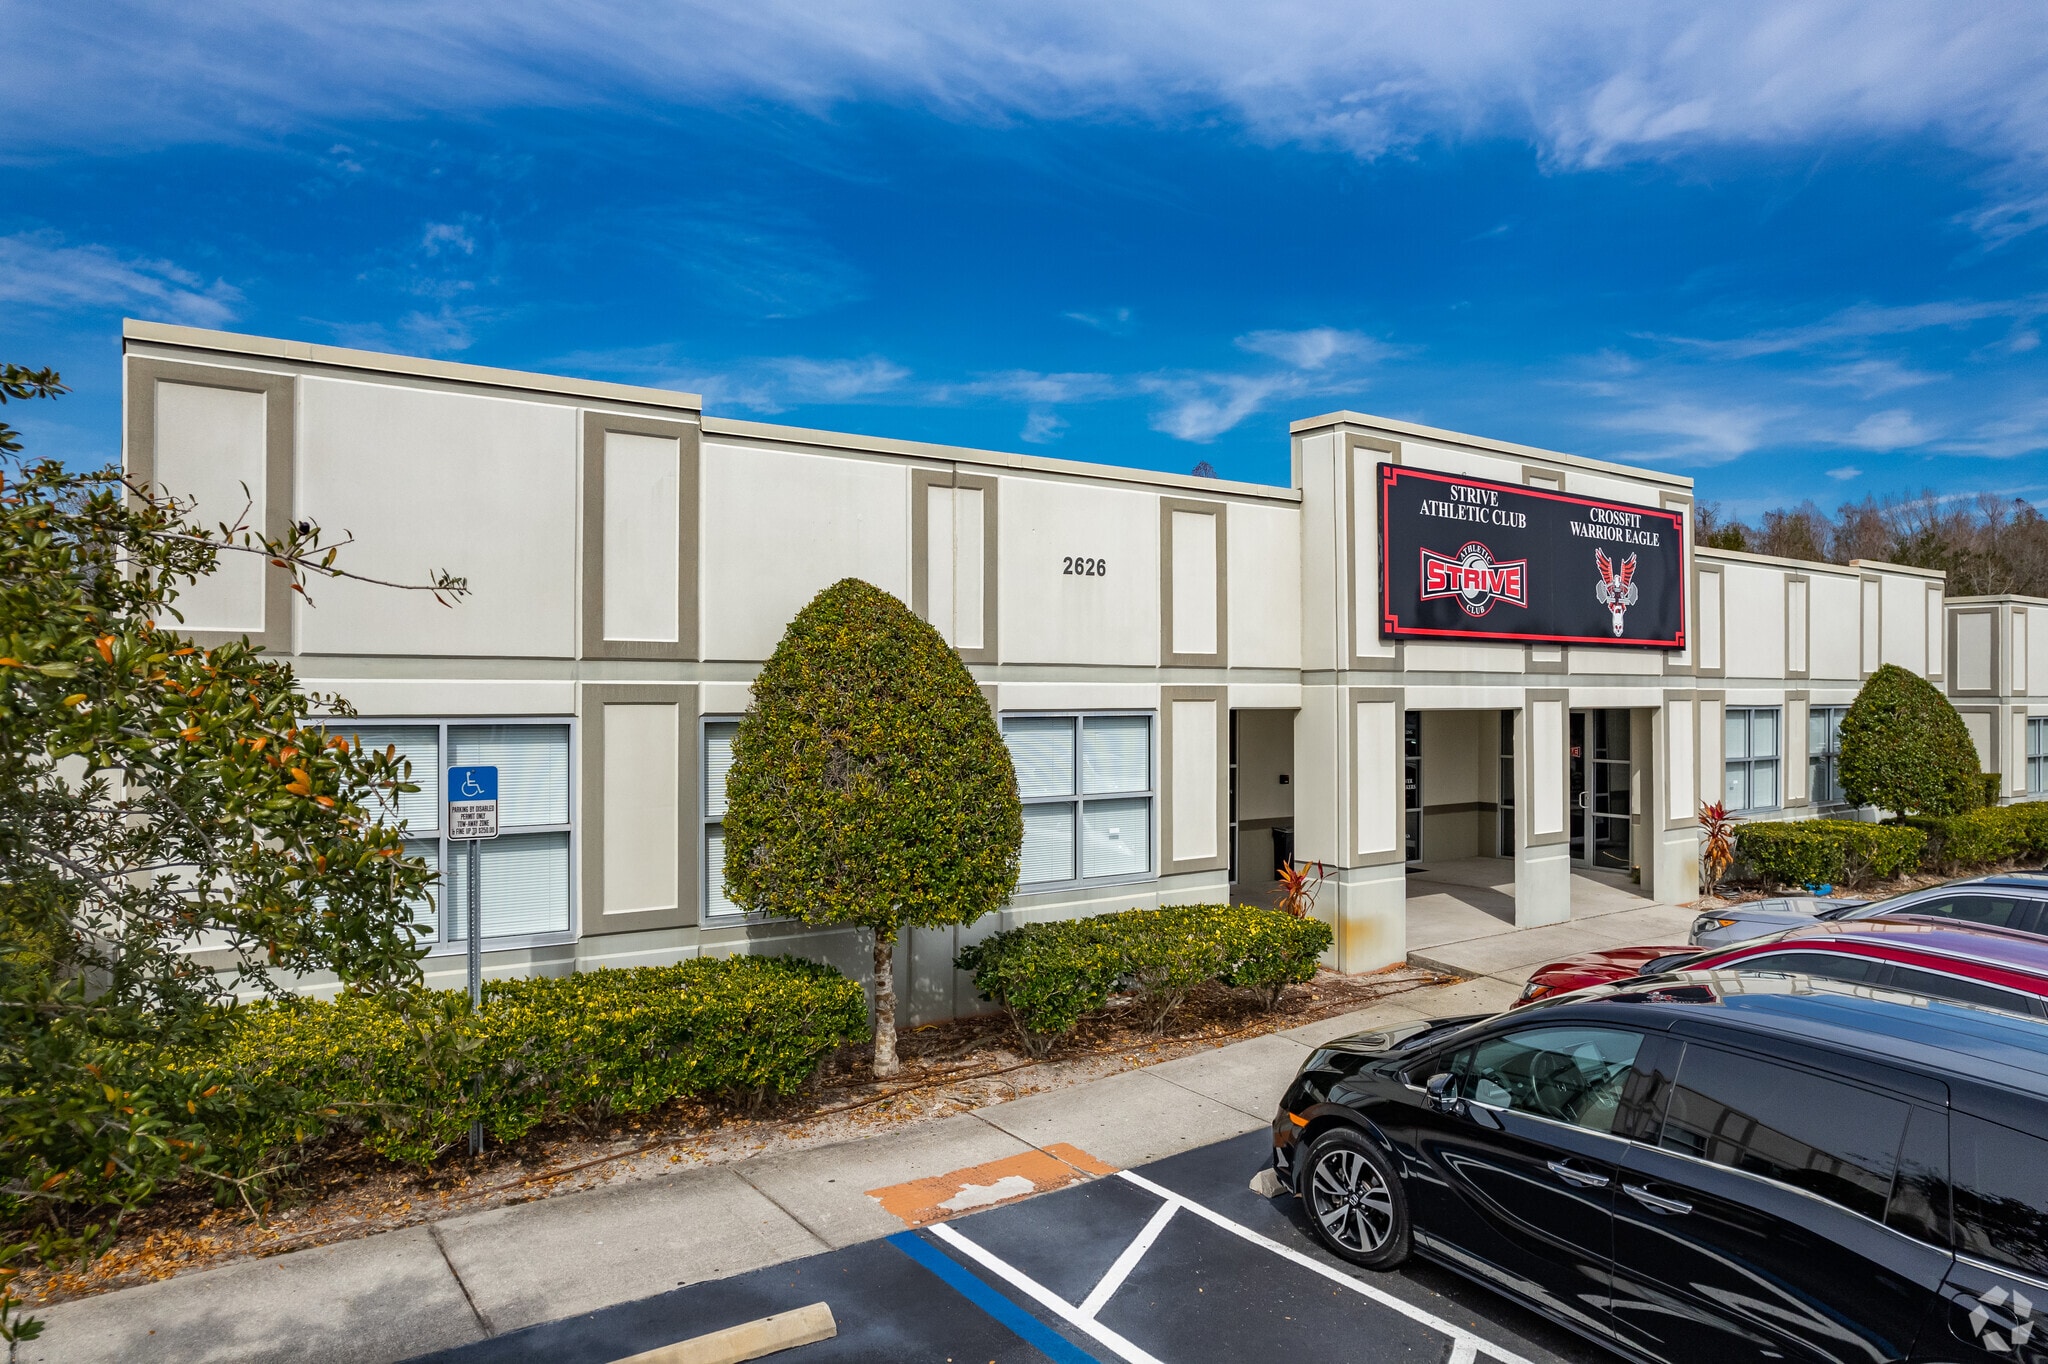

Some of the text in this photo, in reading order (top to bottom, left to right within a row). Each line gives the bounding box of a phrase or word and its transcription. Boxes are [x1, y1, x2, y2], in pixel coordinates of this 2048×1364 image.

[1450, 484, 1499, 507] STRIVE
[1419, 499, 1527, 528] ATHLETIC CLUB
[1589, 507, 1642, 528] CROSSFIT
[1570, 520, 1660, 546] WARRIOR EAGLE
[1460, 544, 1493, 564] ATHLETIC
[1063, 556, 1106, 577] 2626
[1427, 559, 1521, 599] STRIVE
[1466, 604, 1485, 615] CLUB
[457, 820, 478, 828] TOW-AWAY
